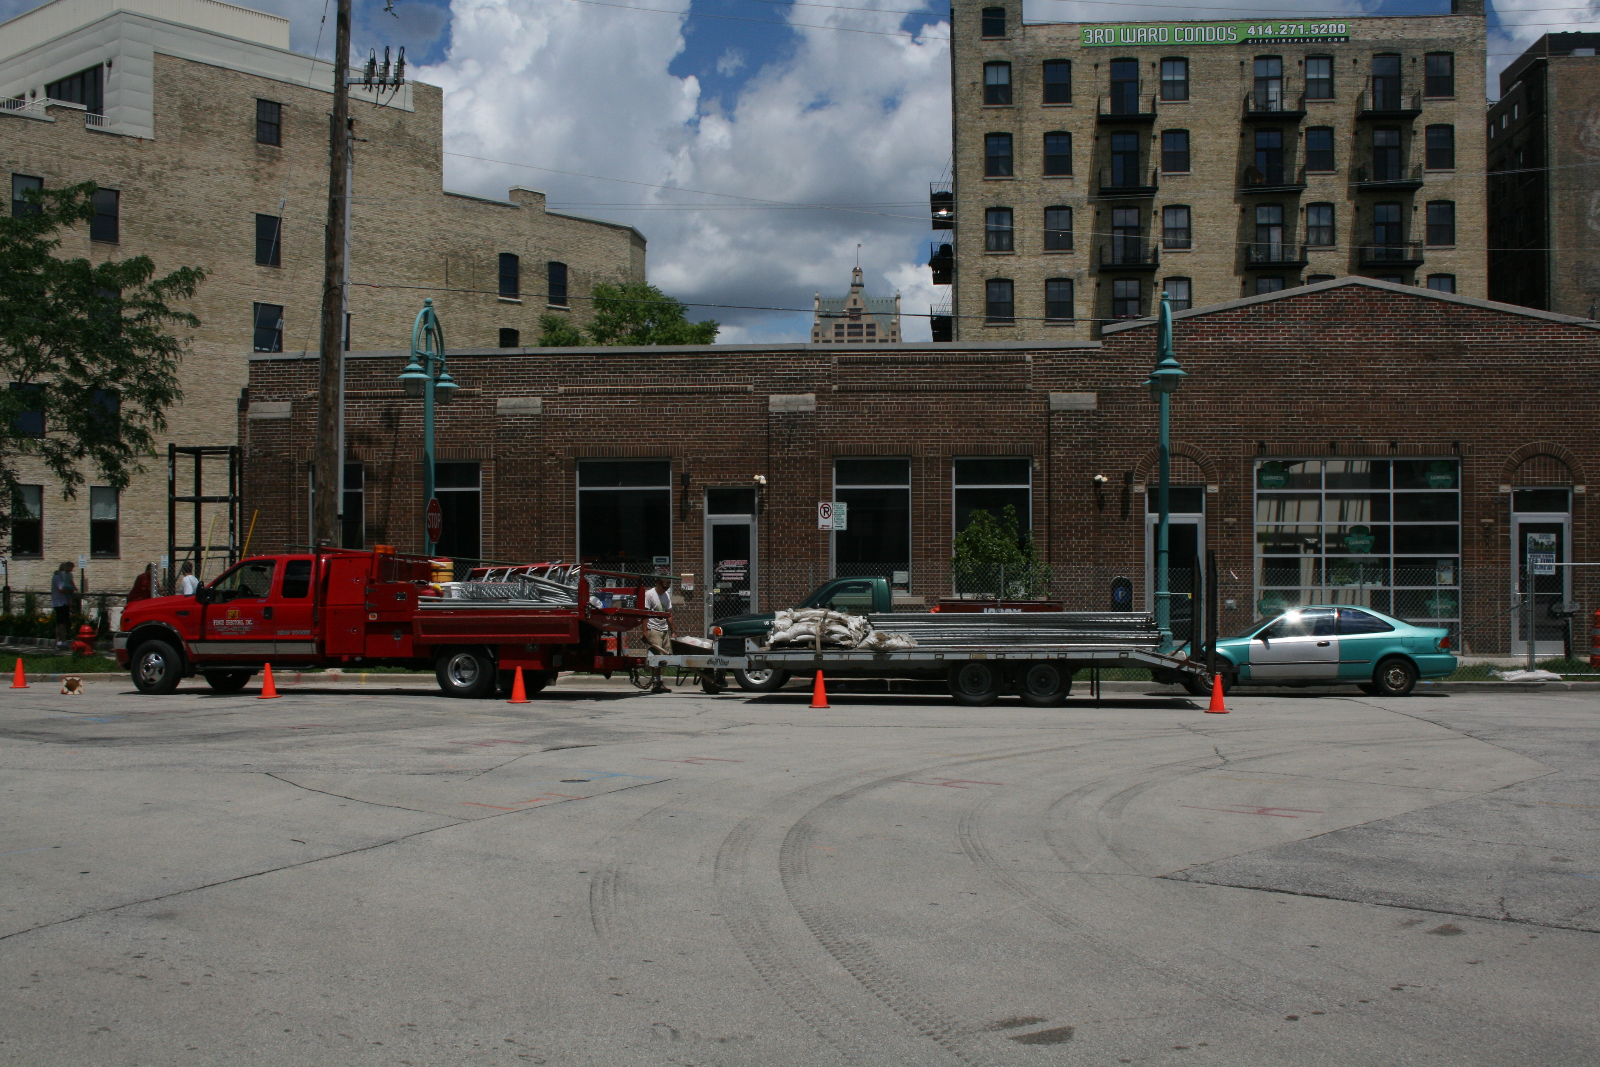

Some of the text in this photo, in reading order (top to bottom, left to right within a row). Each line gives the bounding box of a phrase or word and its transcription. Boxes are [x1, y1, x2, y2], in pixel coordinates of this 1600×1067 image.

[1083, 26, 1238, 45] 3RD WARD CONDOS
[1247, 23, 1346, 36] 414.271.5200
[427, 513, 441, 529] STOP
